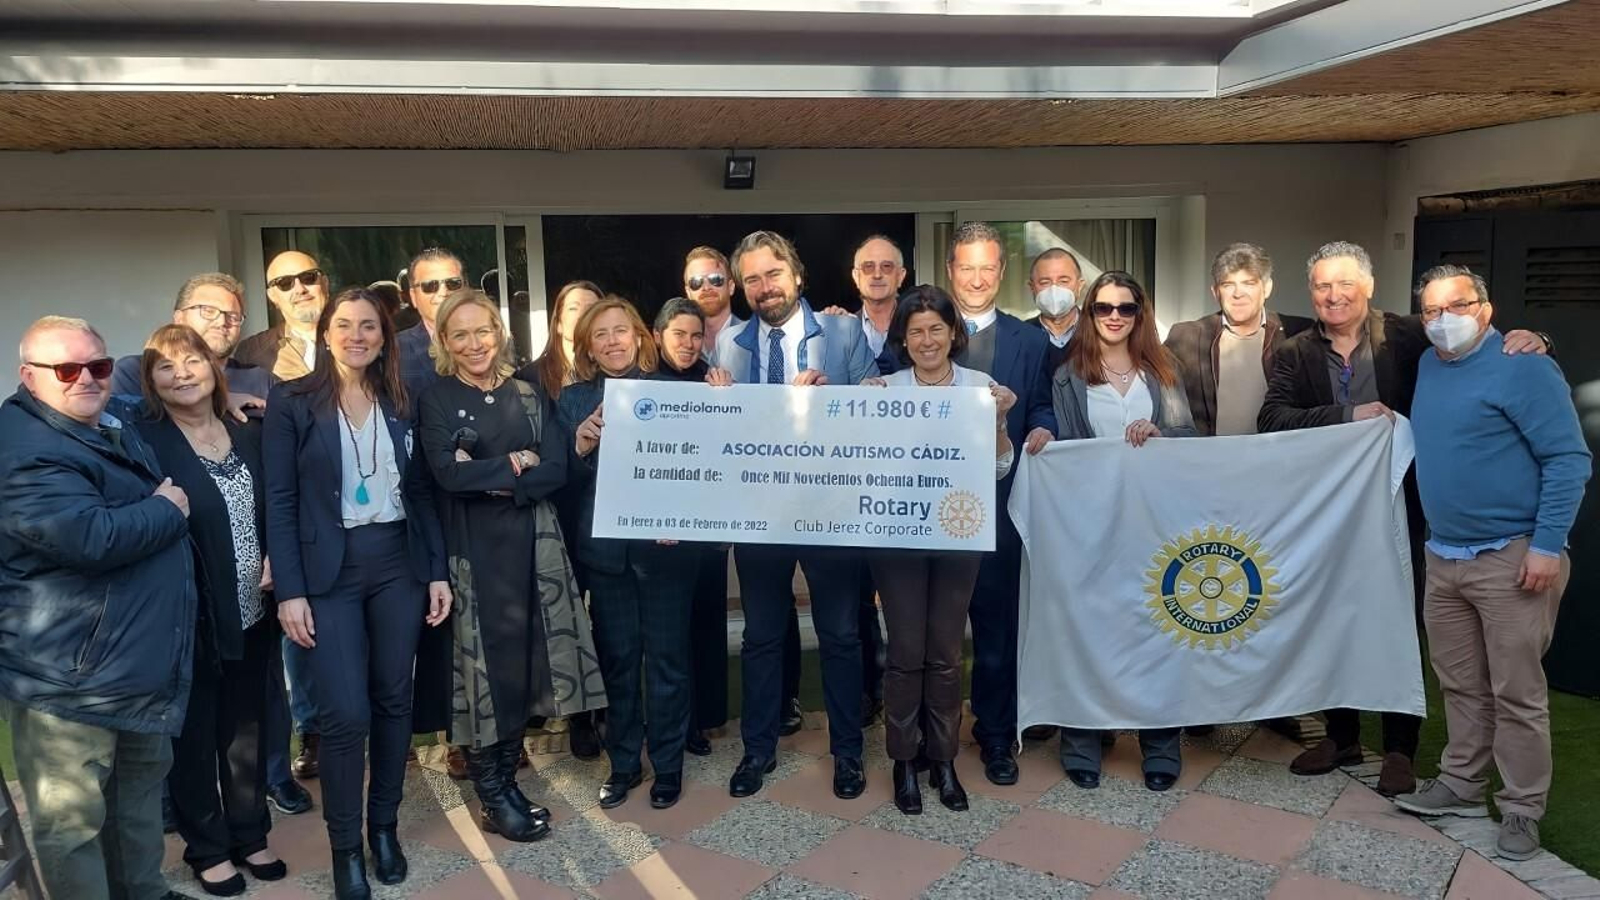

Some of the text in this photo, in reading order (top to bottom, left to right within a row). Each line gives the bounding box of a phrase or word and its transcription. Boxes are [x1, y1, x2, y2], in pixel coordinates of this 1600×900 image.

[660, 400, 742, 415] mediolanum
[846, 399, 916, 418] 11.980
[920, 400, 931, 418] €
[635, 440, 966, 461] A favor de: ASOCIACIÓN AUTISMO CÁDIZ.
[649, 467, 701, 481] cantidad
[704, 468, 723, 482] de:
[740, 469, 770, 484] Once
[773, 471, 790, 485] Mil
[794, 471, 862, 486] Novecientos
[865, 473, 914, 487] Ochenta
[917, 474, 953, 488] Euros.
[859, 495, 932, 521] Rotary
[617, 515, 768, 531] En Jerez a 03 de Febrero de 2022
[794, 519, 933, 538] Club Jerez Corporate
[1182, 543, 1242, 562] ROTARY
[1164, 597, 1258, 634] INTERNATIONAL
